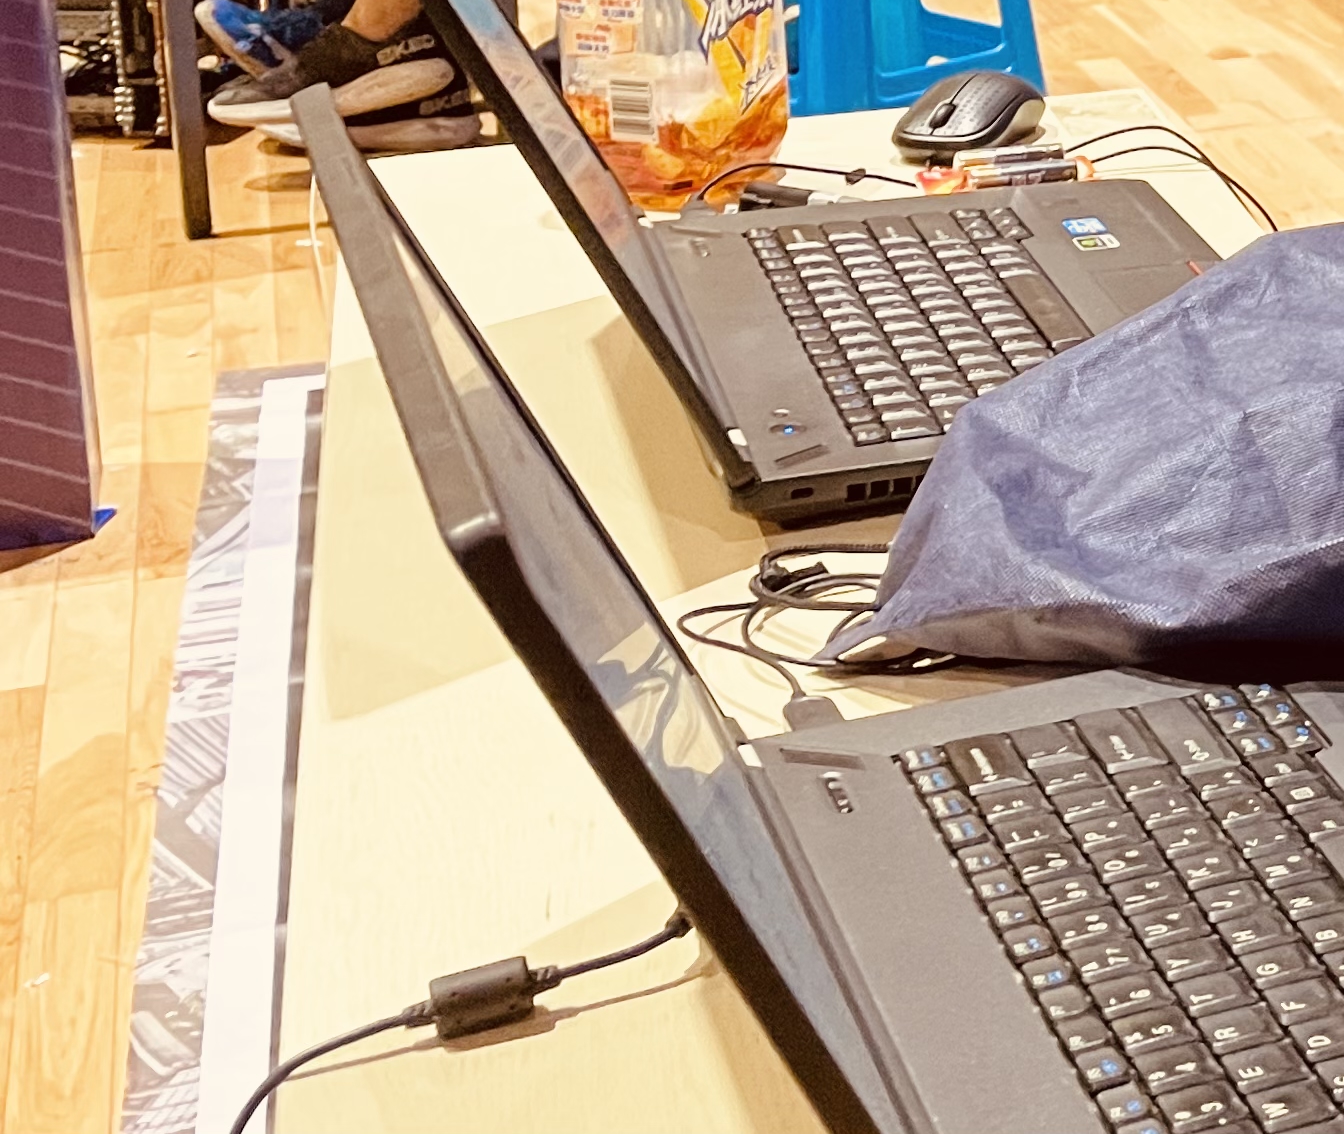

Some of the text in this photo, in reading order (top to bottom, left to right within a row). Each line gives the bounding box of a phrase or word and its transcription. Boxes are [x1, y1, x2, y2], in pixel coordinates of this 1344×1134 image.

[1085, 832, 1107, 842] P
[1104, 860, 1125, 870] O
[1187, 868, 1210, 877] K
[1265, 865, 1288, 877] M
[1211, 900, 1233, 909] J
[1290, 897, 1313, 907] N
[1145, 924, 1168, 935] U
[1316, 929, 1338, 940] B
[1232, 930, 1256, 941] H
[1166, 958, 1189, 968] Y
[1257, 963, 1280, 975] G
[1130, 989, 1150, 999] 6
[1190, 993, 1214, 1005] T
[1281, 1000, 1306, 1012] F
[1151, 1024, 1173, 1035] 5
[1214, 1026, 1239, 1041] R
[1307, 1035, 1331, 1047] D
[1238, 1065, 1264, 1079] E
[1262, 1102, 1289, 1118] W
